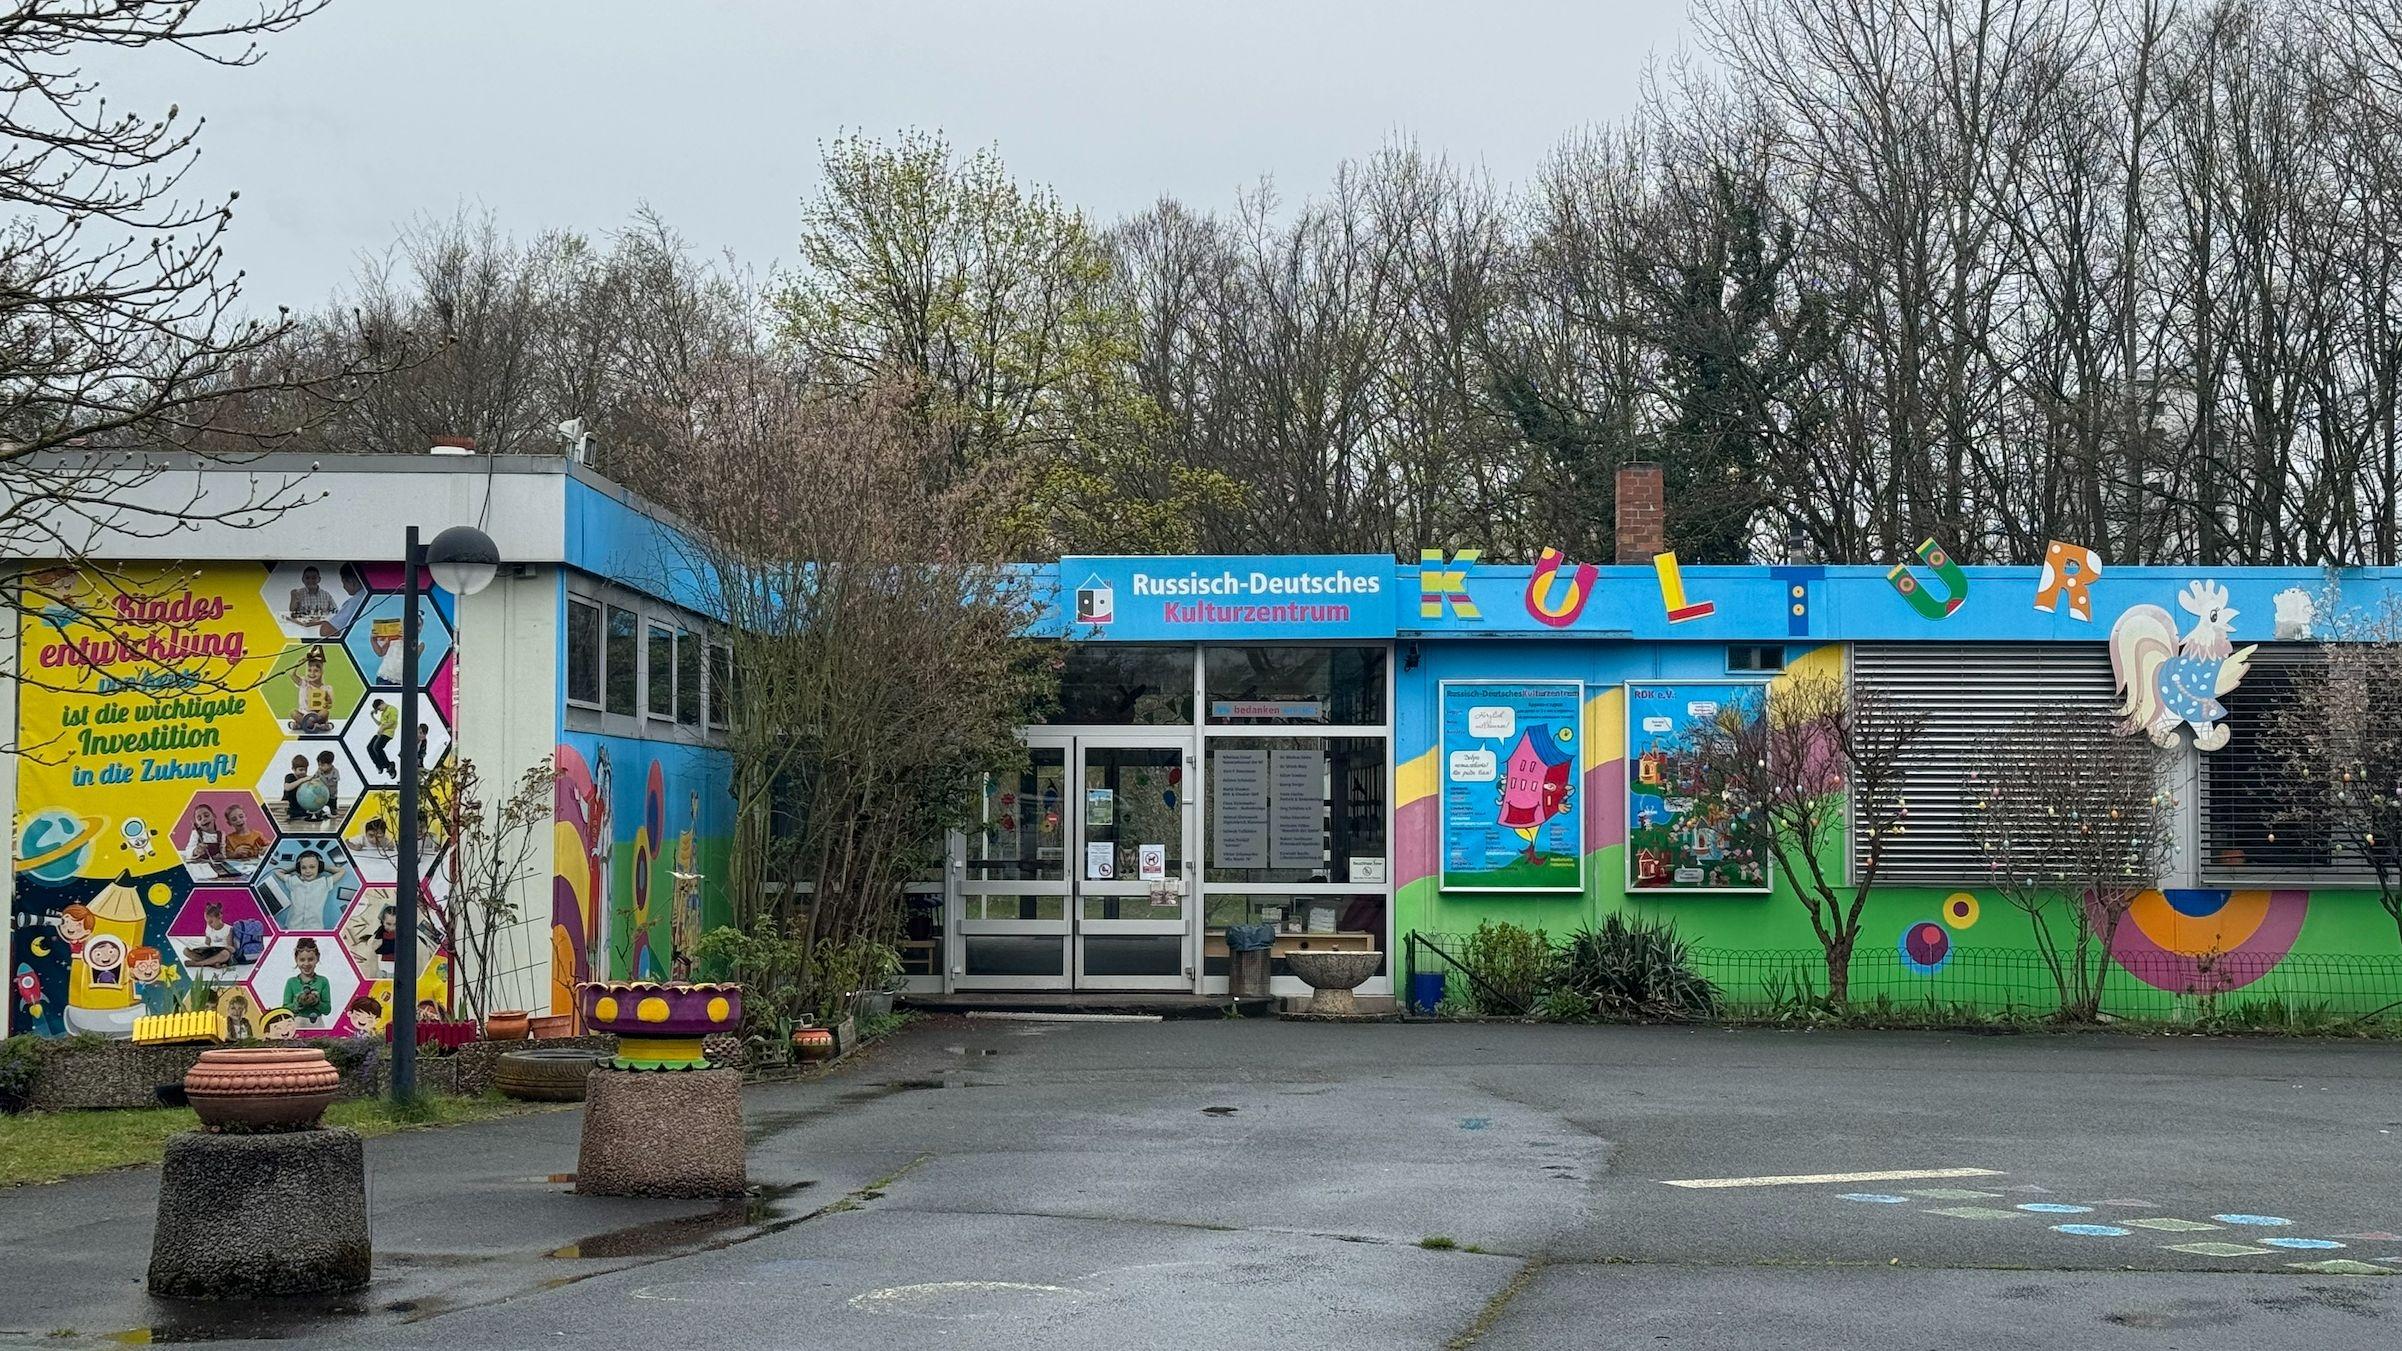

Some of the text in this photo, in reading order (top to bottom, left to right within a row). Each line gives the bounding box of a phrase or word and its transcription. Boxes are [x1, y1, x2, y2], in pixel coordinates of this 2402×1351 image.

[1133, 570, 1380, 596] Russisch-Deutsches
[112, 592, 233, 626] Kindes-
[1163, 600, 1350, 624] Kulturzentrum
[40, 628, 244, 667] entwicklung
[1233, 705, 1280, 715] bedanken
[1634, 690, 1655, 699] RDK
[61, 695, 246, 727] ist die wichtigste
[77, 723, 221, 756] Investition
[72, 754, 238, 786] in die Zukunft!
